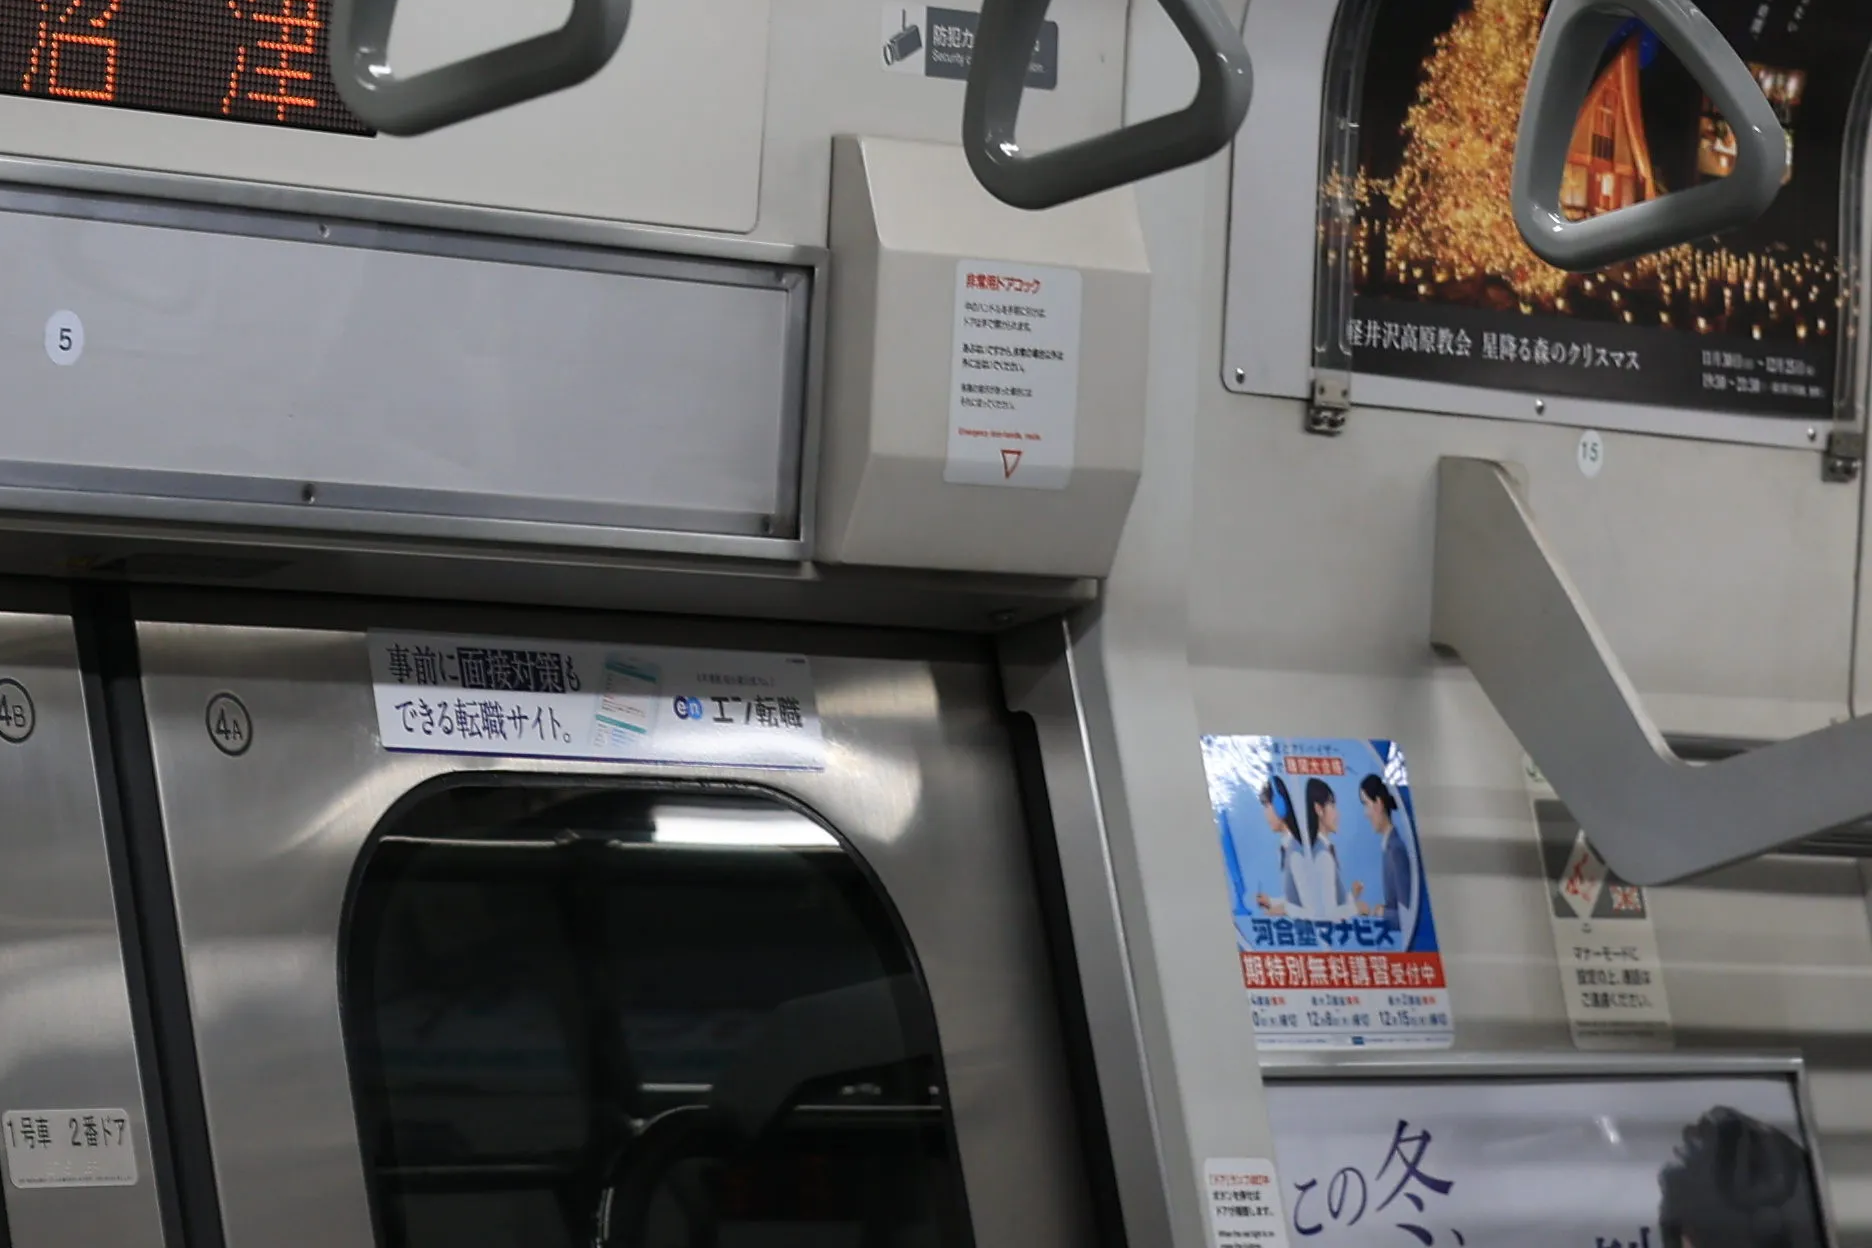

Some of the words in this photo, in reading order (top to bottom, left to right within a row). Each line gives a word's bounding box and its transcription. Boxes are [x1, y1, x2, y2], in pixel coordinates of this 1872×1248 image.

[966, 272, 1041, 294] 非常用ドアコック
[58, 327, 73, 352] 5
[1346, 318, 1473, 358] 軽井沢高原教会
[1481, 332, 1641, 371] 星降る森のクリスマス
[1581, 441, 1600, 463] 15
[385, 643, 583, 693] 事前に面接対策も
[215, 707, 244, 742] 4A
[394, 698, 573, 744] できる転職サイト。
[673, 694, 703, 721] en
[710, 695, 805, 729] エン転職
[1251, 917, 1395, 947] 河合塾マナビス
[7, 1116, 52, 1150] 1号車
[68, 1114, 127, 1149] 2番ドア
